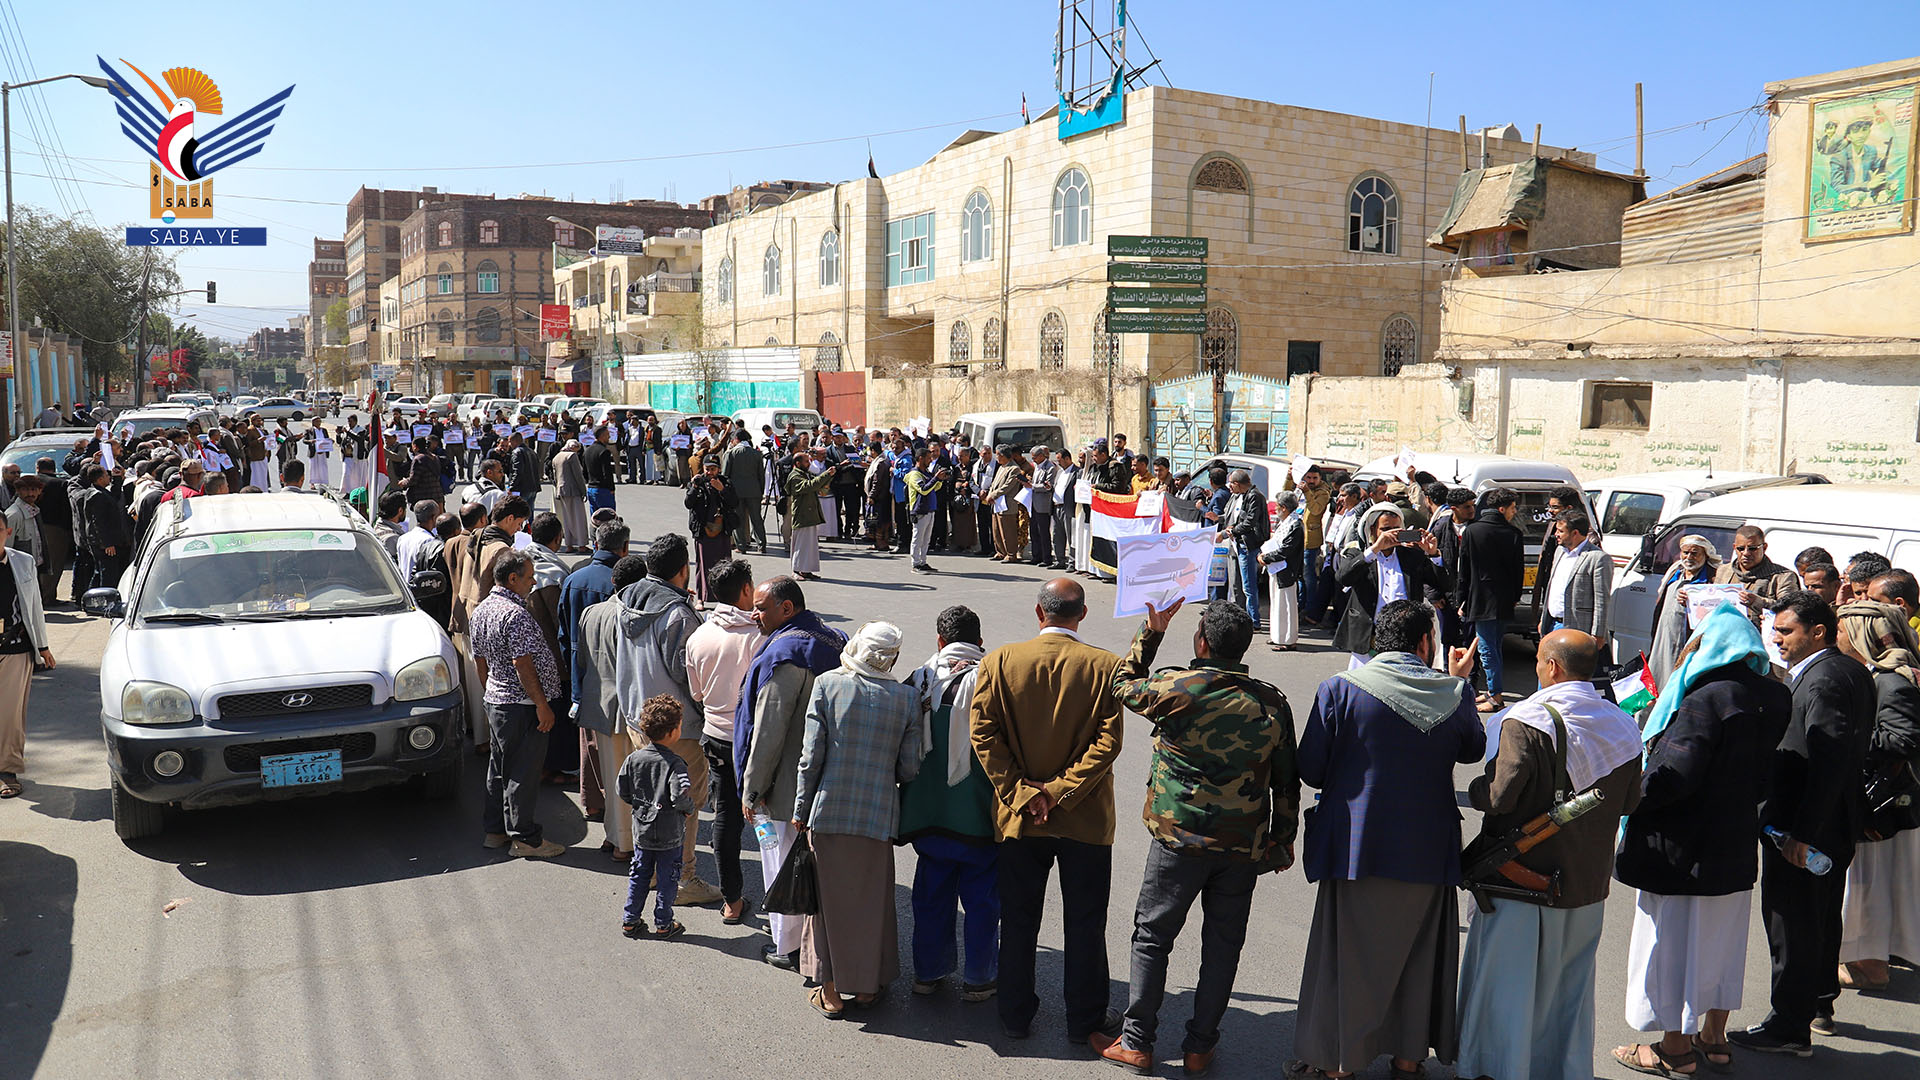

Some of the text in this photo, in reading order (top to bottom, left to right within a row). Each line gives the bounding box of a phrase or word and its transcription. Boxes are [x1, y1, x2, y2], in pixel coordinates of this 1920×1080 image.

[1826, 441, 1888, 452] لقد كانت ثورة
[1879, 456, 1907, 466] الامام
[1878, 468, 1898, 480] ثورة
[310, 752, 333, 762] اليمن
